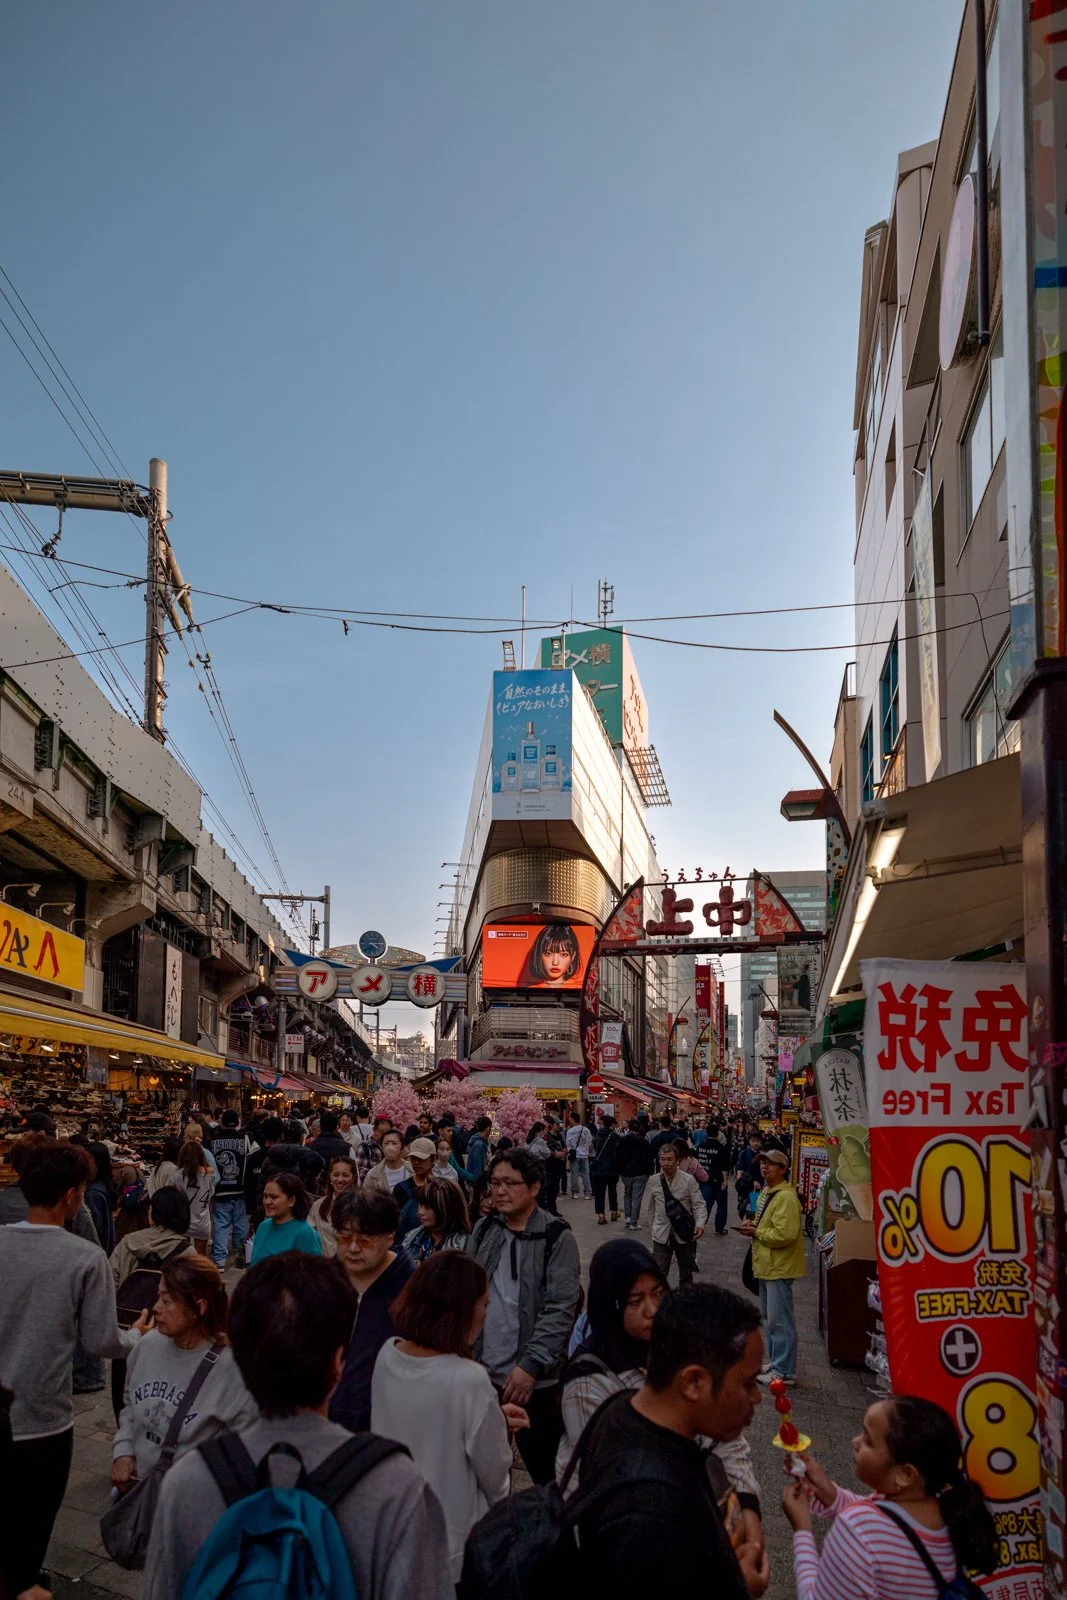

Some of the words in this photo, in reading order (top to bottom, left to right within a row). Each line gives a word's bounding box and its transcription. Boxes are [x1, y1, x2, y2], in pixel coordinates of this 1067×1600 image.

[661, 866, 737, 883] うえちゅん
[645, 885, 752, 937] 上中
[305, 971, 438, 998] アメ横
[186, 1184, 210, 1209] 74
[134, 1381, 199, 1425] NEBRASA
